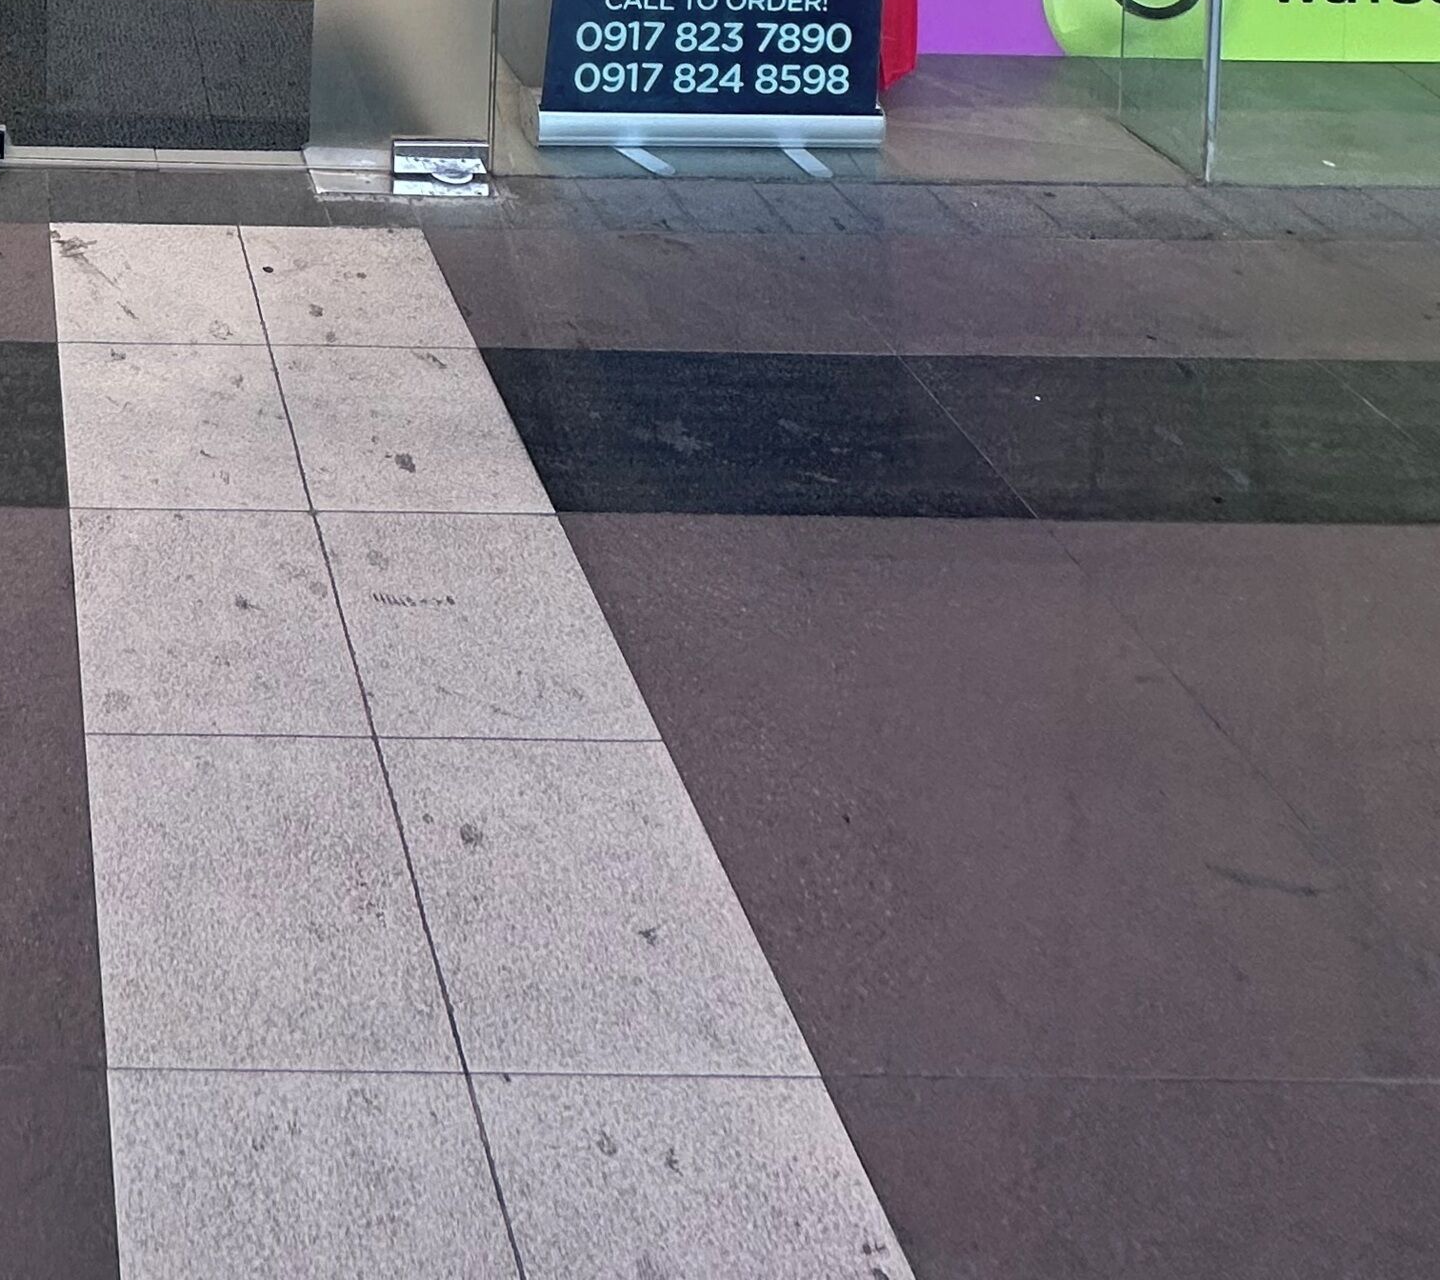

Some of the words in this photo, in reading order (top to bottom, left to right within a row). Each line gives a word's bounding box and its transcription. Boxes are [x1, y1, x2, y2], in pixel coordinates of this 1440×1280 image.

[575, 21, 666, 53] 0917
[674, 22, 744, 53] 823
[755, 22, 853, 54] 7890
[574, 61, 664, 93] 0917
[672, 63, 744, 93] 824
[754, 64, 850, 95] 8598
